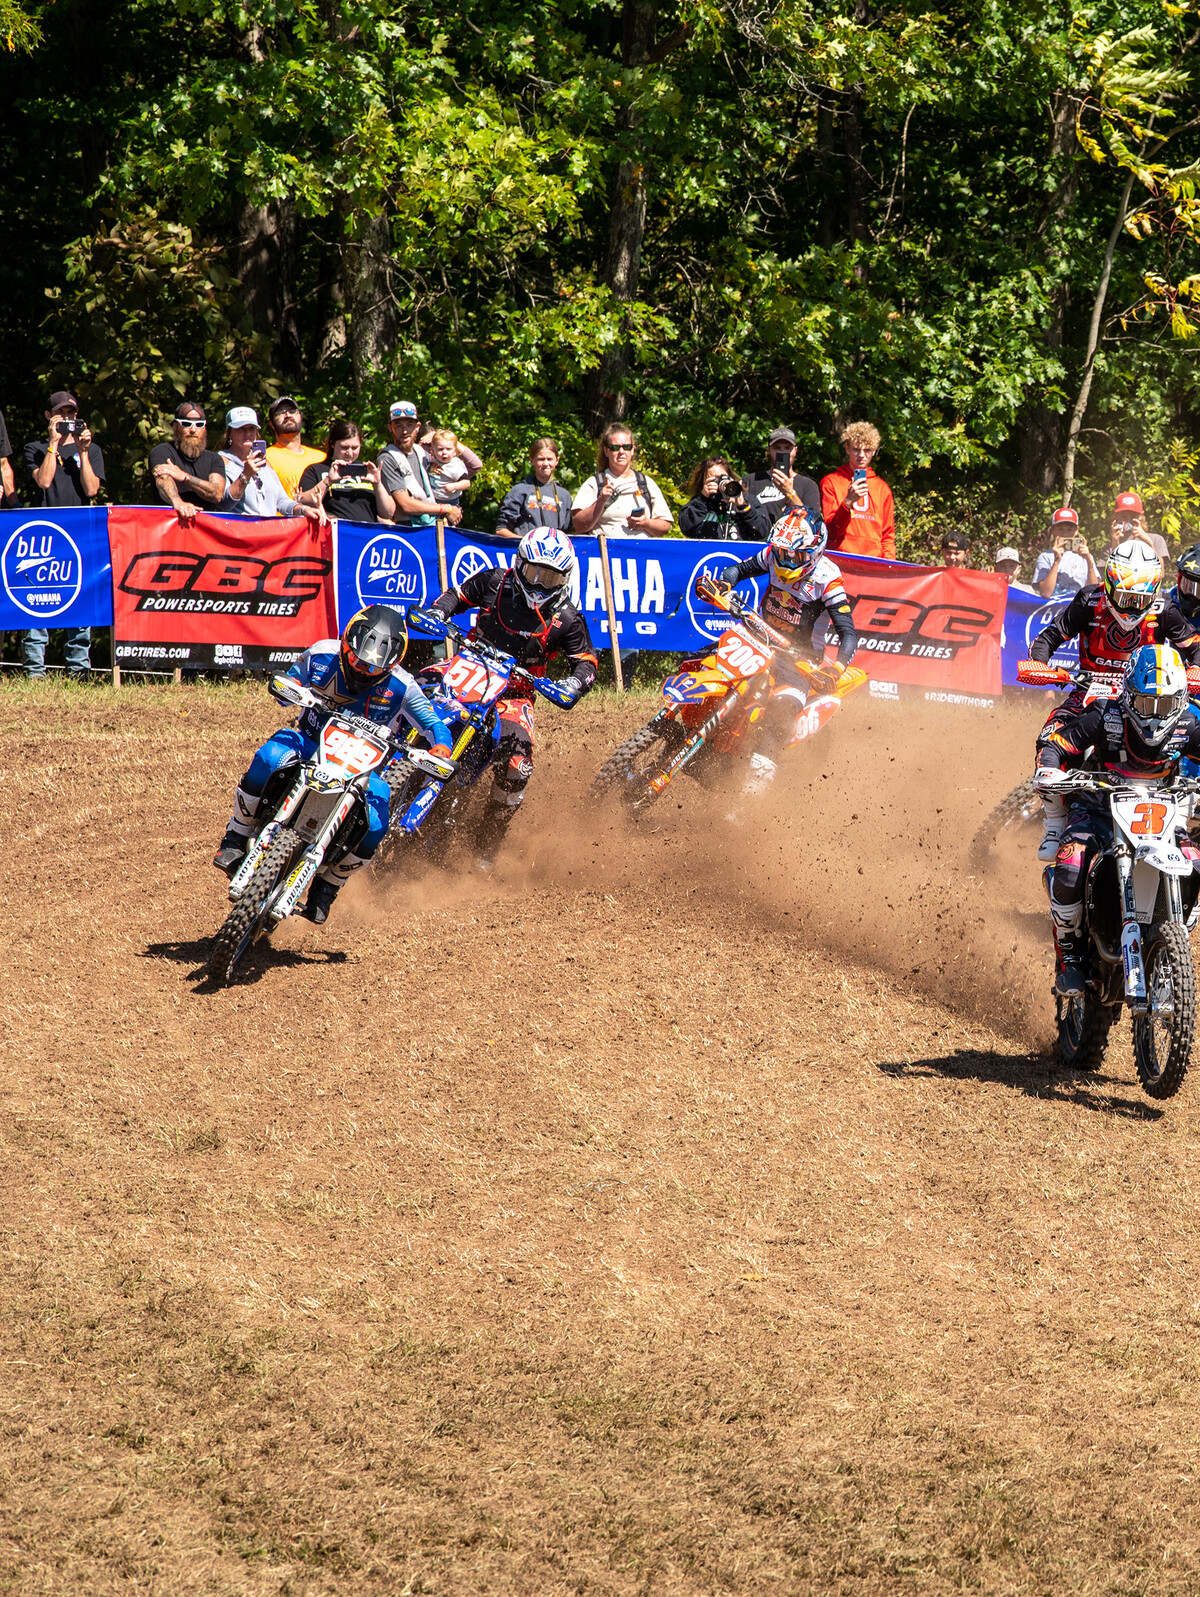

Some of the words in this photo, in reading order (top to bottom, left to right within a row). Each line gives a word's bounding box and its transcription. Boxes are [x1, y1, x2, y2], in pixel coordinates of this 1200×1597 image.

[117, 550, 333, 601] GBC
[142, 597, 251, 614] POWERSPORTS
[256, 602, 295, 616] TIRES
[846, 593, 995, 648] BC
[115, 645, 191, 659] GBCTIRES.COM
[717, 636, 766, 677] 206
[909, 644, 953, 659] TIRES
[442, 658, 506, 704] 514
[1130, 802, 1168, 835] 3
